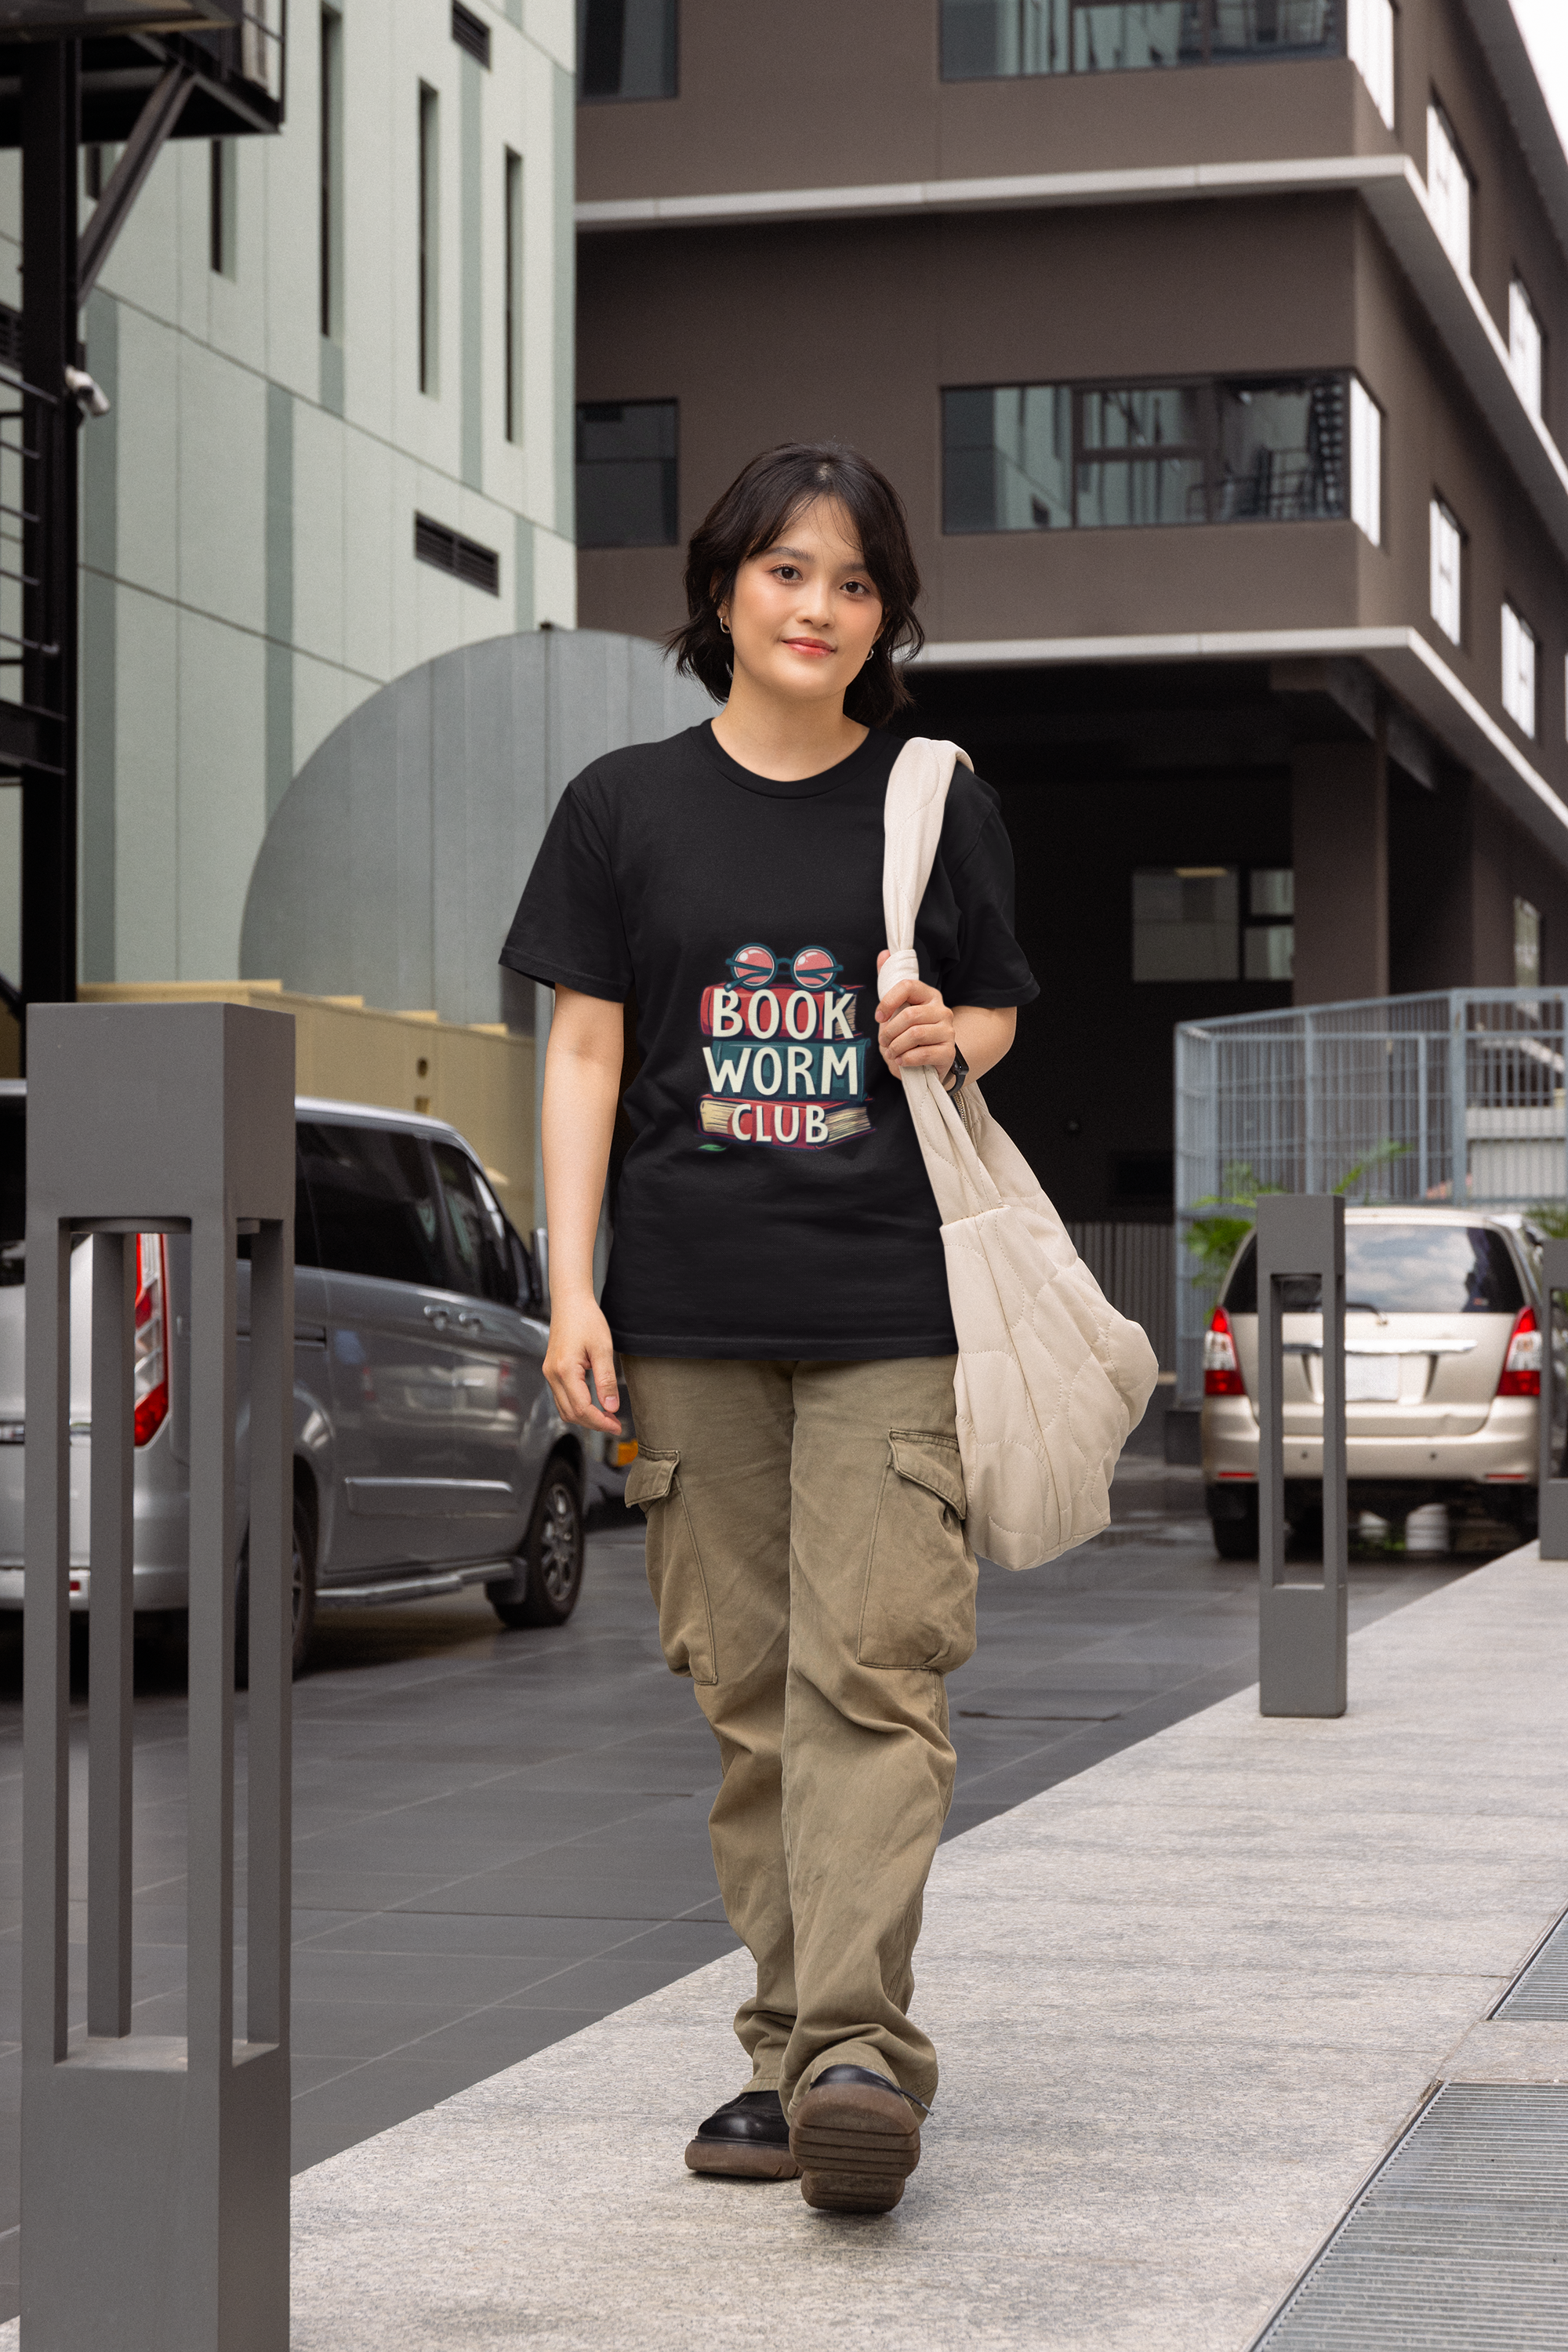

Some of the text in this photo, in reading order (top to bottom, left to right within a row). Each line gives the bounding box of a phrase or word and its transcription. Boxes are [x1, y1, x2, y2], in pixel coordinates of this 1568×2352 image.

[713, 989, 854, 1040] BOOK
[702, 1046, 858, 1095] WORM
[731, 1104, 829, 1143] CLUB
